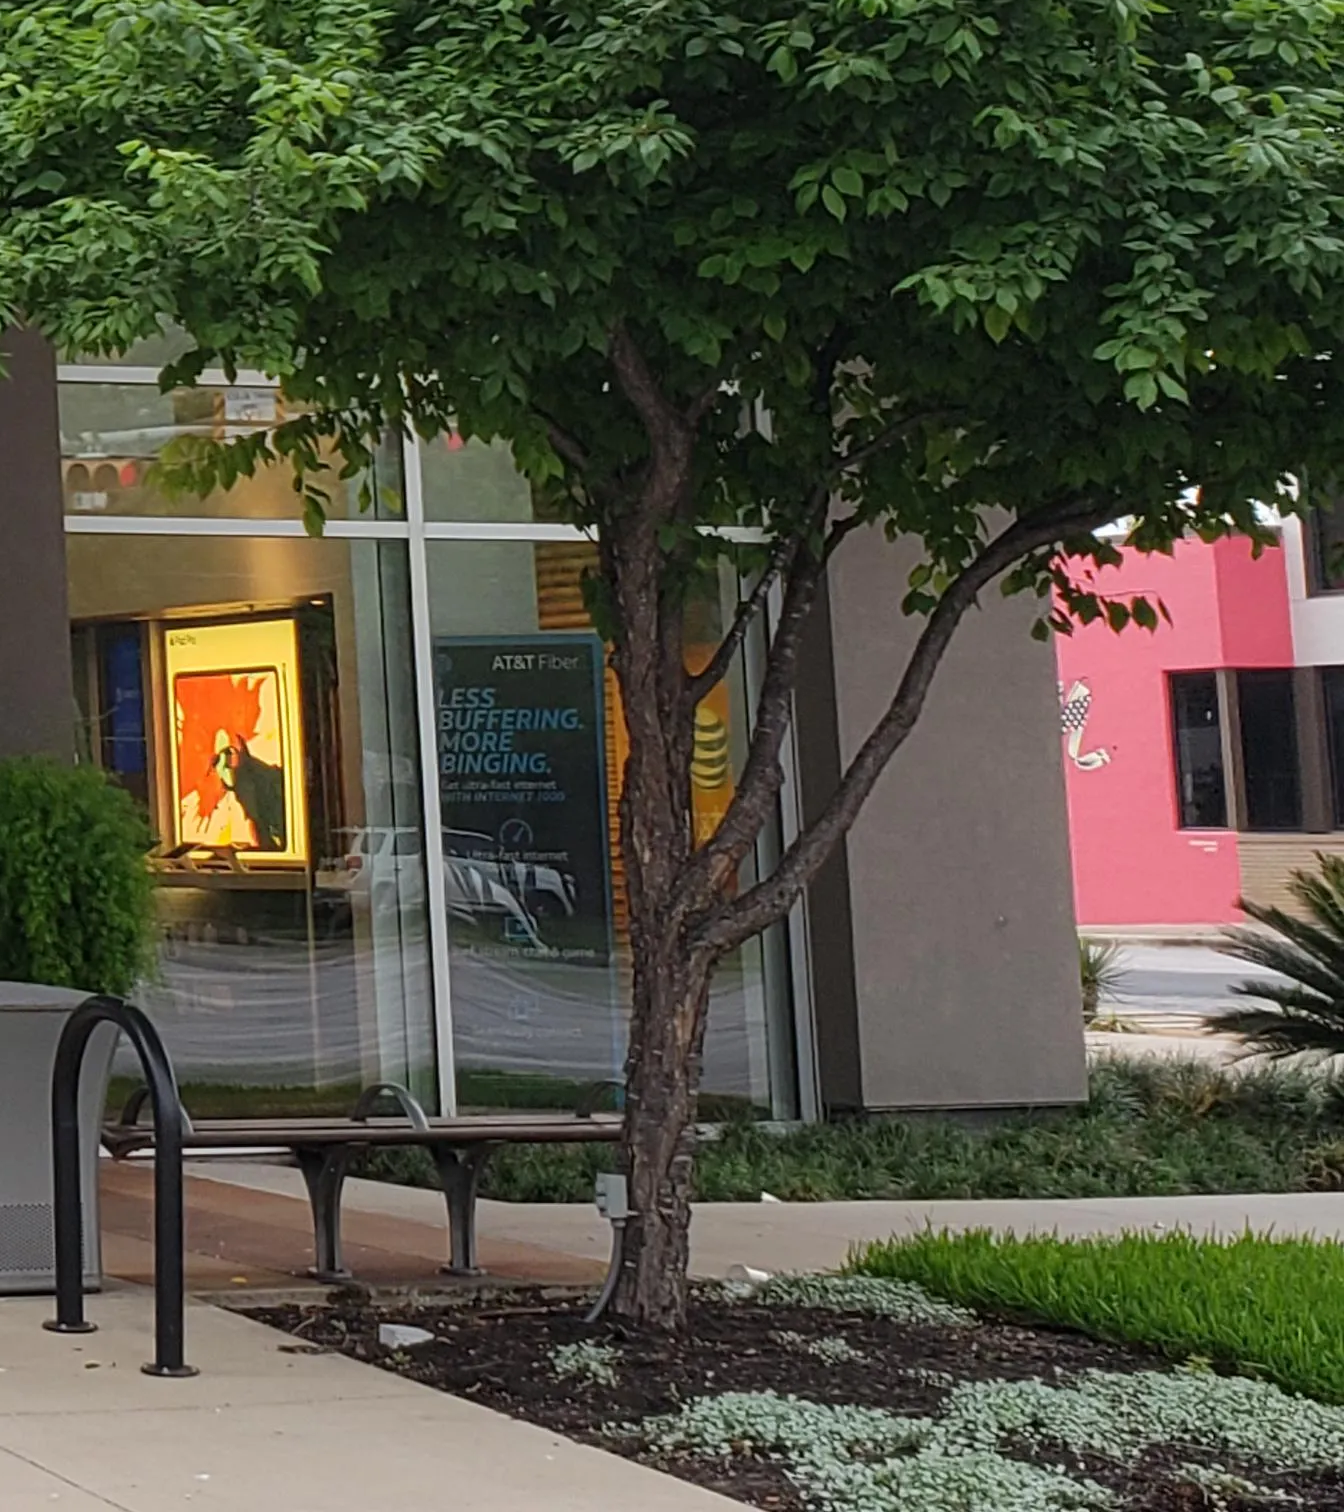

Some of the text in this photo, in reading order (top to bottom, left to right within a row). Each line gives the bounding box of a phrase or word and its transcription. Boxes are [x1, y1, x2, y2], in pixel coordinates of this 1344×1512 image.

[492, 654, 579, 671] AT&T Fiber
[438, 688, 497, 709] LESS
[439, 708, 585, 730] BUFFERING.
[439, 731, 514, 753] MORE
[440, 752, 552, 775] BINGING.
